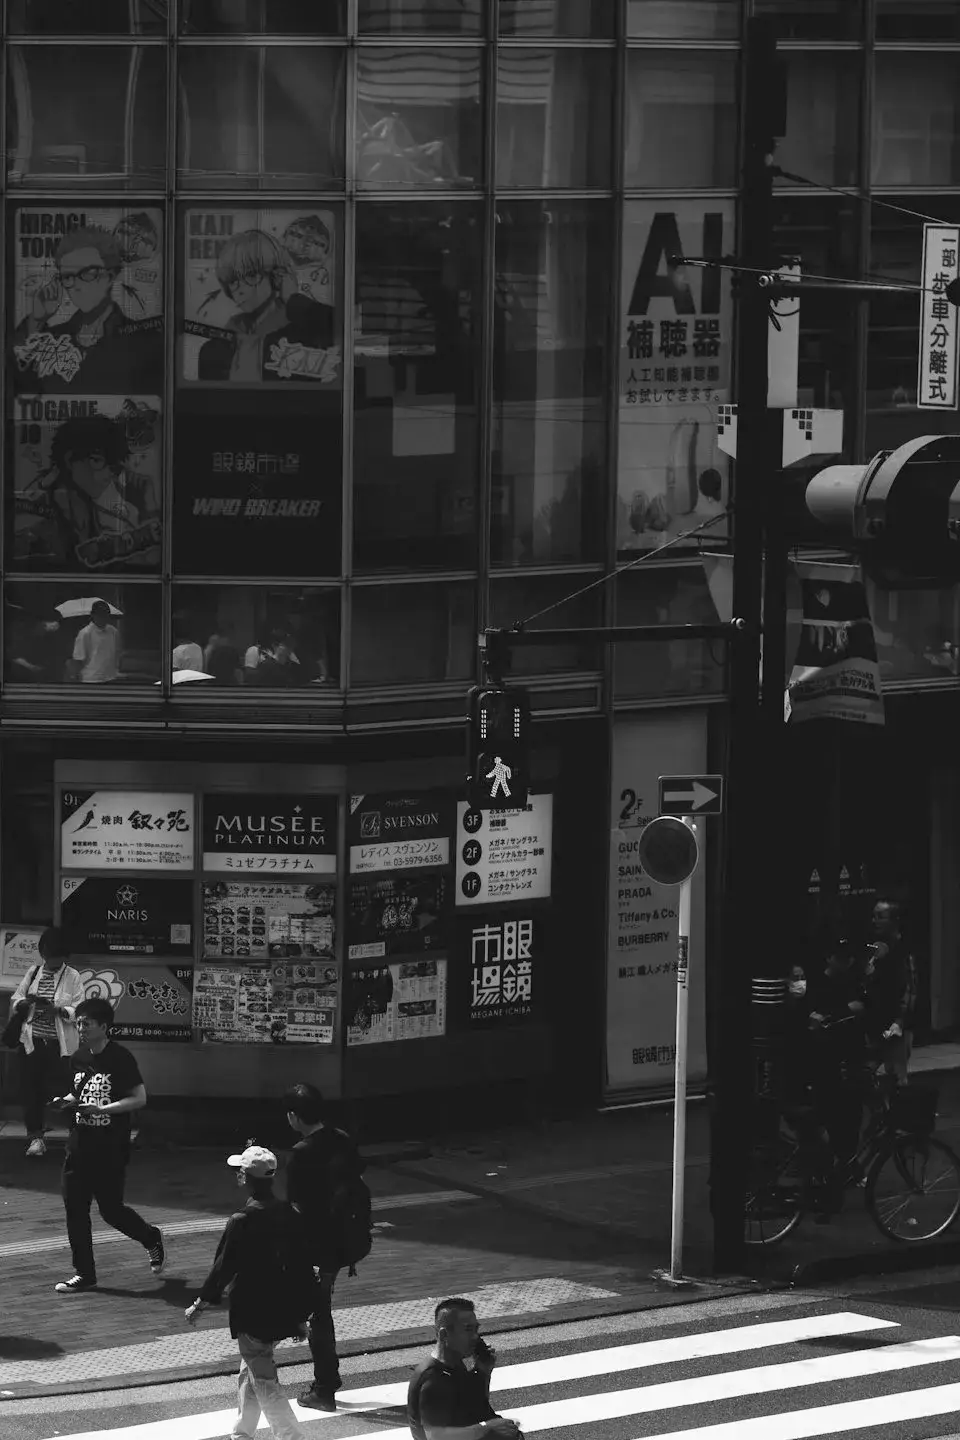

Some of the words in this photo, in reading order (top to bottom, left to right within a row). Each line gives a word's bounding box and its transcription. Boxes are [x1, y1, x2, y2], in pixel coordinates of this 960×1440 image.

[627, 212, 723, 315] AI
[627, 320, 721, 359] 補聴器
[19, 399, 98, 421] TOGAME
[244, 498, 324, 518] BREAKER
[101, 815, 123, 825] 焼肉
[127, 809, 190, 832] 叙々苑
[384, 812, 439, 830] SVENSON
[467, 814, 479, 827] 3F
[215, 834, 326, 845] PLATINUM
[466, 847, 478, 859] 2F
[618, 841, 639, 853] GUC
[225, 857, 315, 870] ミュゼプラチナム
[618, 865, 644, 877] SAIN
[64, 879, 78, 889] 6F
[466, 879, 478, 891] 1F
[488, 881, 533, 892] コンタクトレンズ
[618, 886, 652, 898] PRADA
[107, 909, 149, 922] NARIS
[618, 911, 651, 924] Tiffany
[661, 908, 677, 919] Co.
[618, 931, 670, 947] BURBERRY
[294, 1011, 327, 1024] 営業中
